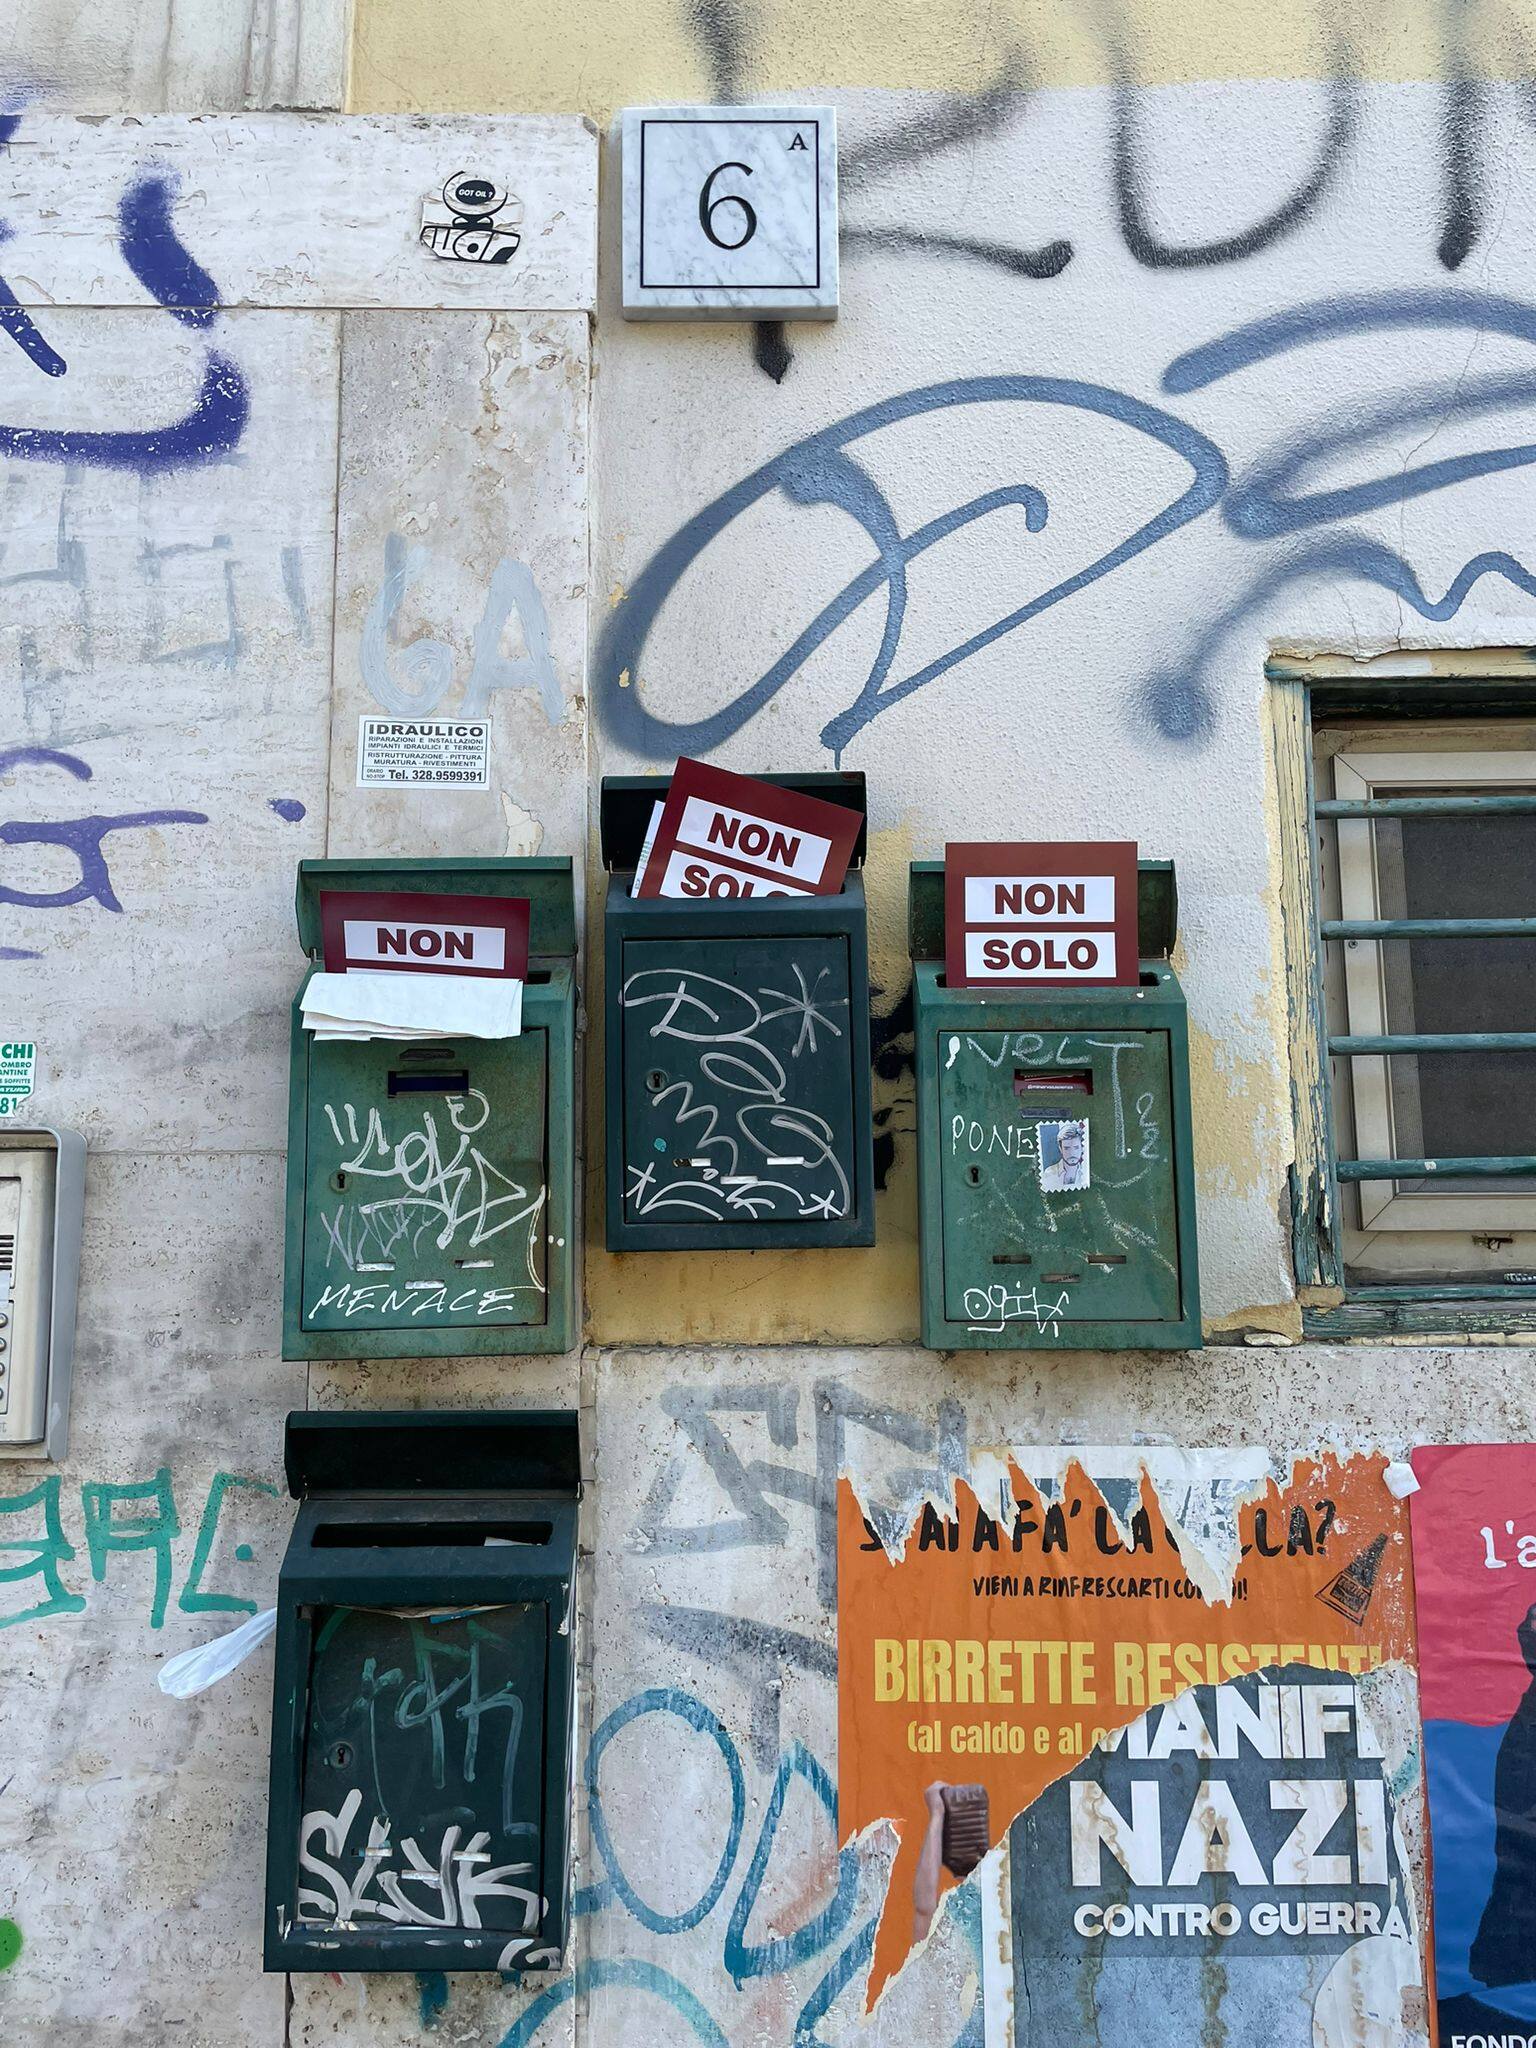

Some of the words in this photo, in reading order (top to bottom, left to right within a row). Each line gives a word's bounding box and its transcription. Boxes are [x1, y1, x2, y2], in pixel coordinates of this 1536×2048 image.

[787, 132, 809, 151] A
[458, 188, 474, 197] GOT
[475, 190, 486, 198] OIL
[699, 161, 757, 251] 6
[369, 724, 484, 736] IDRAULICO
[367, 752, 443, 760] RISTRUTTURAZIONE
[389, 769, 408, 780] Tel.
[412, 770, 482, 781] 328.9599391
[707, 812, 801, 868] NON
[680, 864, 790, 897] SO
[994, 883, 1085, 915] NON
[376, 927, 474, 960] NON
[983, 939, 1098, 970] SOLO
[1023, 1576, 1034, 1597] A
[1039, 1576, 1170, 1599] RINFRESCARTI
[874, 1639, 1097, 1704] BIRRETTE
[907, 1720, 941, 1753] (al
[950, 1720, 1025, 1754] caldo
[1033, 1725, 1050, 1754] e
[1058, 1722, 1083, 1755] al
[1069, 1780, 1388, 1887] NAZI
[1073, 1903, 1242, 1938] CONTRO
